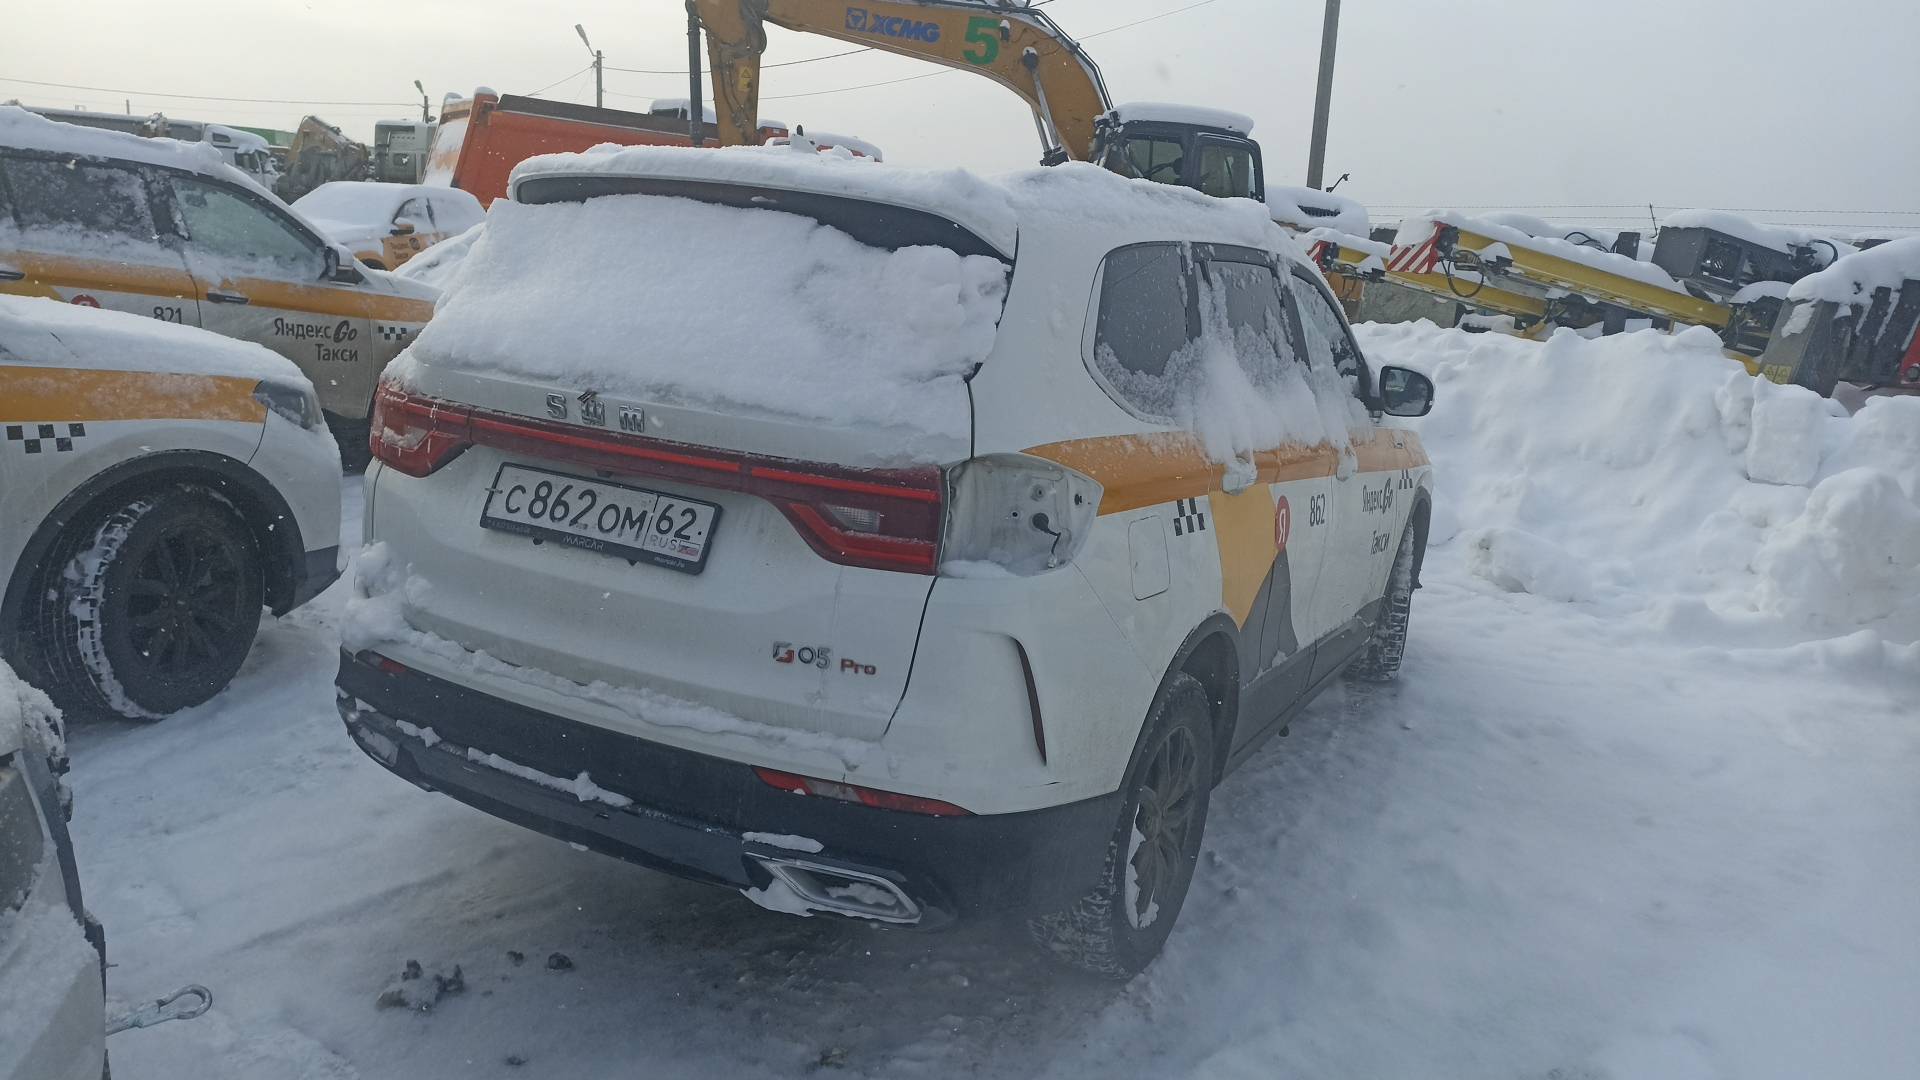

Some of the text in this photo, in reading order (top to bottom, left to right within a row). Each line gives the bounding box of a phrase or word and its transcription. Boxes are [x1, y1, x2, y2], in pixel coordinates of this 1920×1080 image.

[870, 14, 940, 43] XCMG
[963, 16, 1000, 65] 5
[153, 306, 182, 324] 821
[273, 318, 357, 342] Яндекс Go
[315, 343, 358, 361] Такси
[1362, 477, 1393, 515] Яндекс Go
[1309, 493, 1326, 527] 862
[1278, 508, 1286, 544] Я
[562, 535, 604, 550] MARCAR
[650, 535, 678, 551] RUS
[1370, 529, 1390, 555] Такси
[841, 658, 876, 675] Pro
